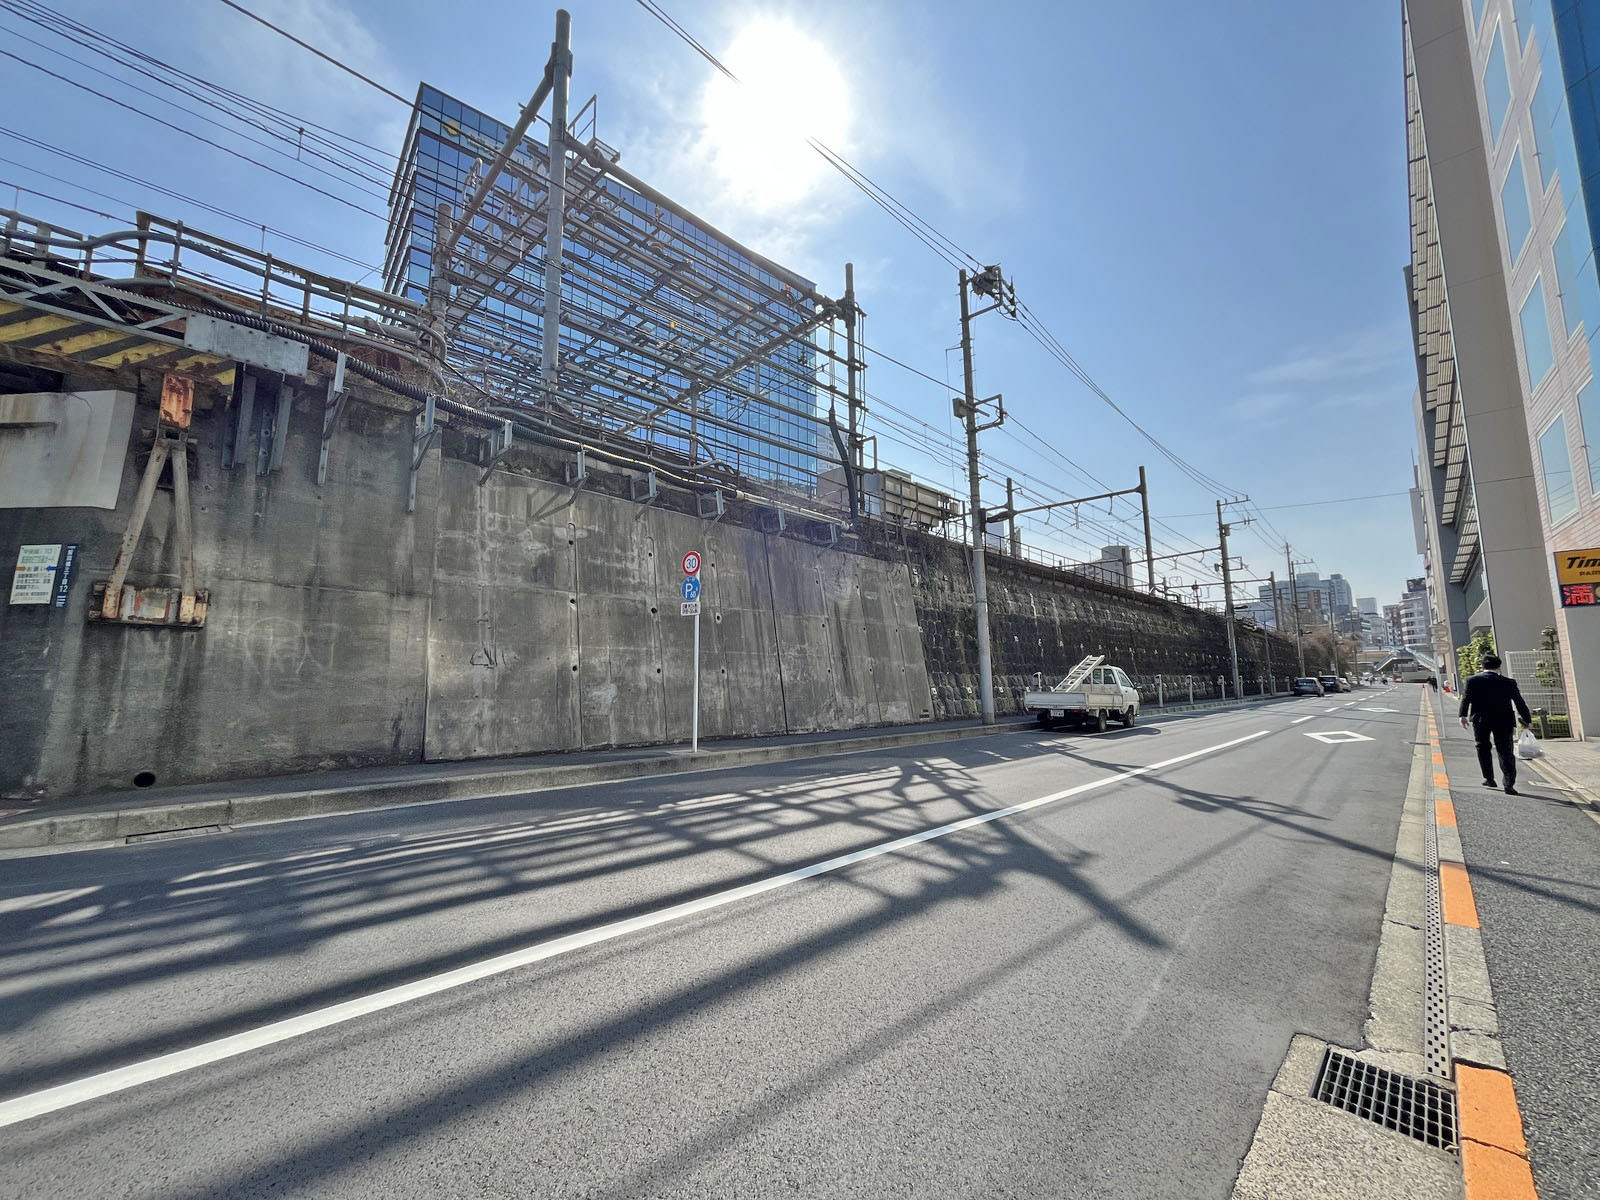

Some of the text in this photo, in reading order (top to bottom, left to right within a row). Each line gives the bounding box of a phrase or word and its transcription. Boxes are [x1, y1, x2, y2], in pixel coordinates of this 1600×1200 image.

[686, 558, 697, 569] 30
[59, 585, 68, 593] 12
[685, 583, 693, 599] P
[1563, 585, 1594, 605] 満
